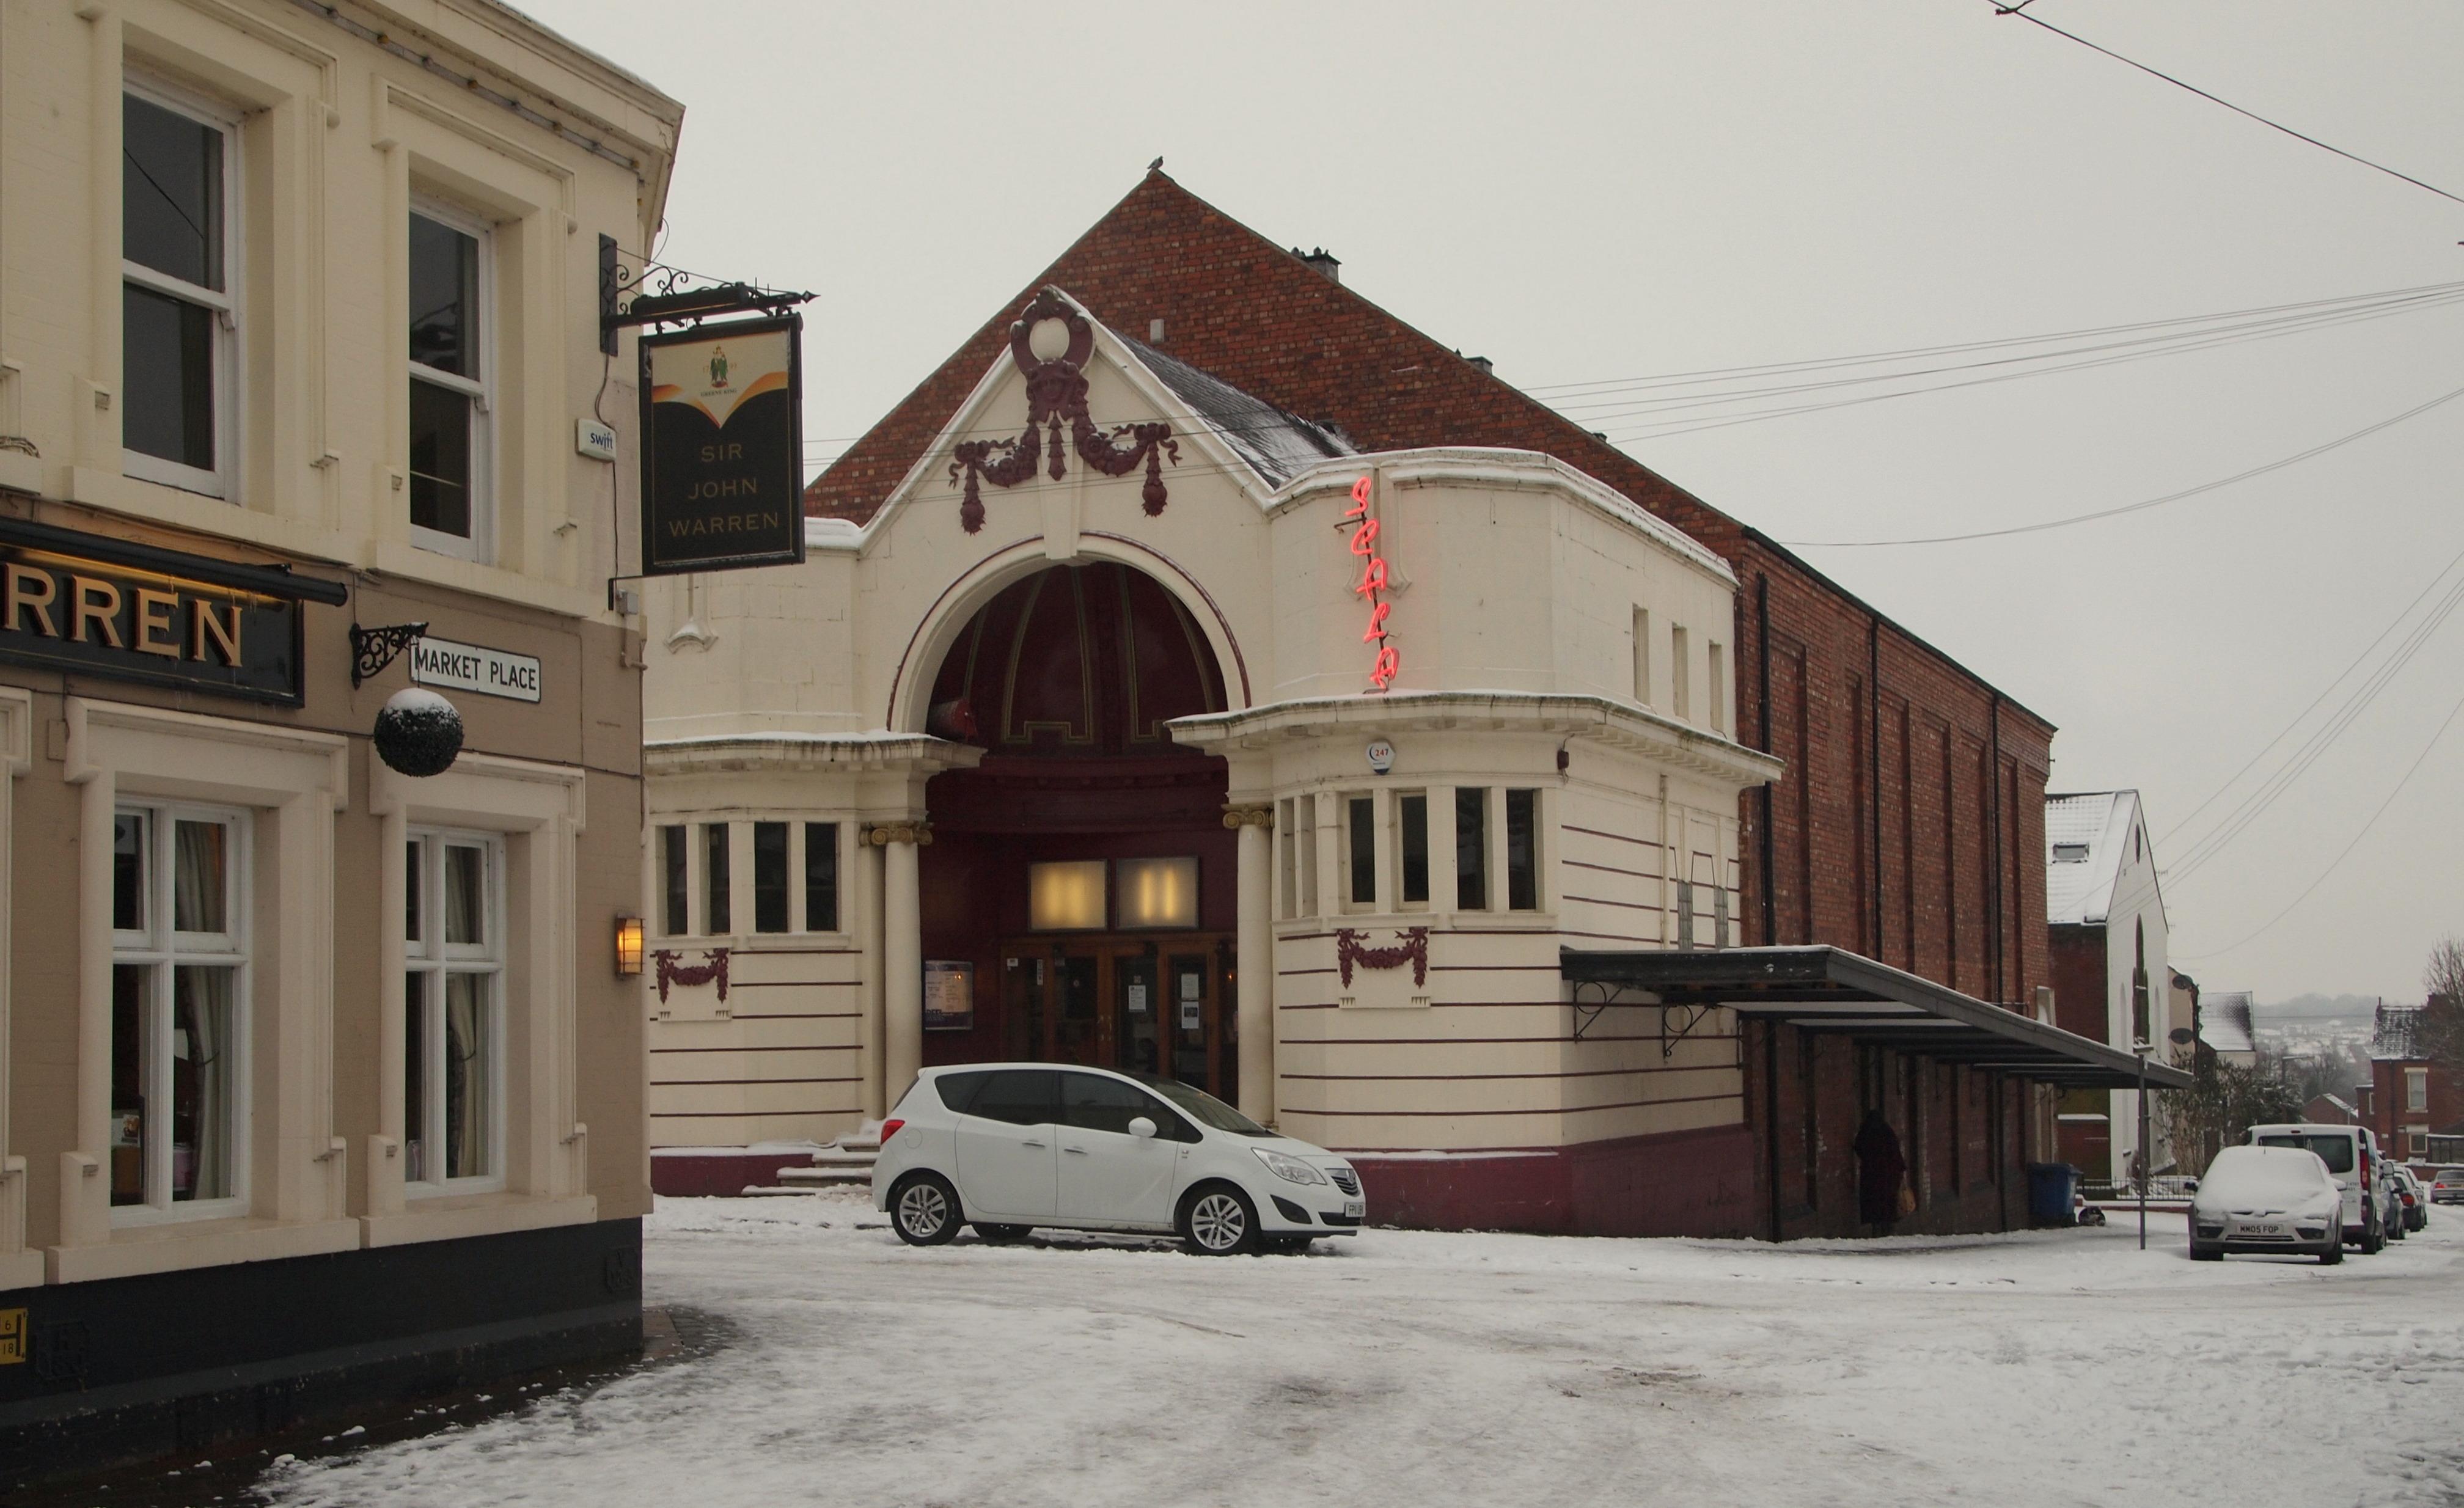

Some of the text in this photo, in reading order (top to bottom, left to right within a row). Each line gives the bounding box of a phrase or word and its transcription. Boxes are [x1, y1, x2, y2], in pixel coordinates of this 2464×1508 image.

[590, 431, 613, 451] swift
[702, 443, 742, 463] SIR
[688, 478, 757, 500] JOHN
[669, 512, 778, 537] WARREN
[1344, 476, 1399, 690] SCALA
[4, 561, 243, 668] RREN
[415, 646, 537, 690] MARKET PLACE
[5, 1320, 11, 1330] 6
[3, 1343, 13, 1355] 18
